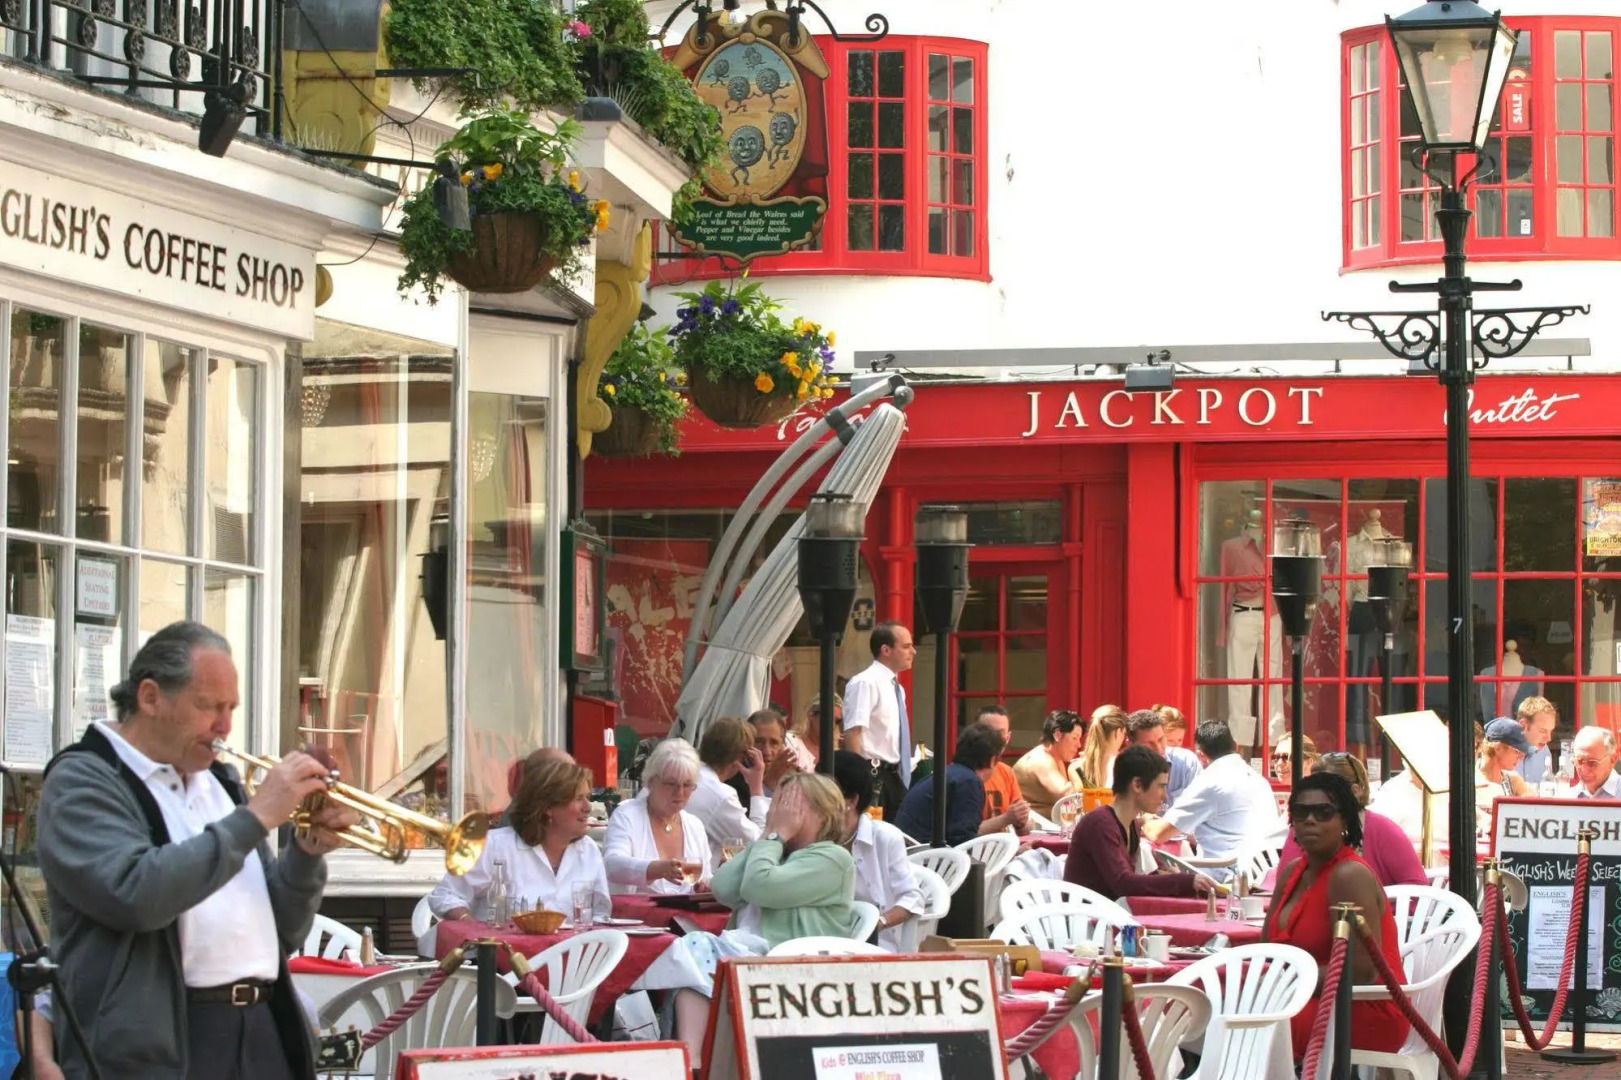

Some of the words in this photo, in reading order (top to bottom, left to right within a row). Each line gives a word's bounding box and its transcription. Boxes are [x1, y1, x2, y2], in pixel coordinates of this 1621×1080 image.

[1512, 93, 1523, 124] SALE
[737, 234, 754, 242] good
[739, 226, 764, 234] Vinegar
[123, 223, 227, 292] COFFEE
[236, 252, 304, 309] SHOP
[1022, 386, 1324, 437] JACKPOT
[1453, 617, 1463, 634] 7
[1557, 860, 1578, 880] WEE
[1230, 910, 1239, 920] 79
[748, 977, 985, 1020] ENGLISH'S
[847, 1052, 881, 1065] ENGLISH'S
[882, 1051, 907, 1064] COFFEE
[907, 1050, 925, 1063] SHOP
